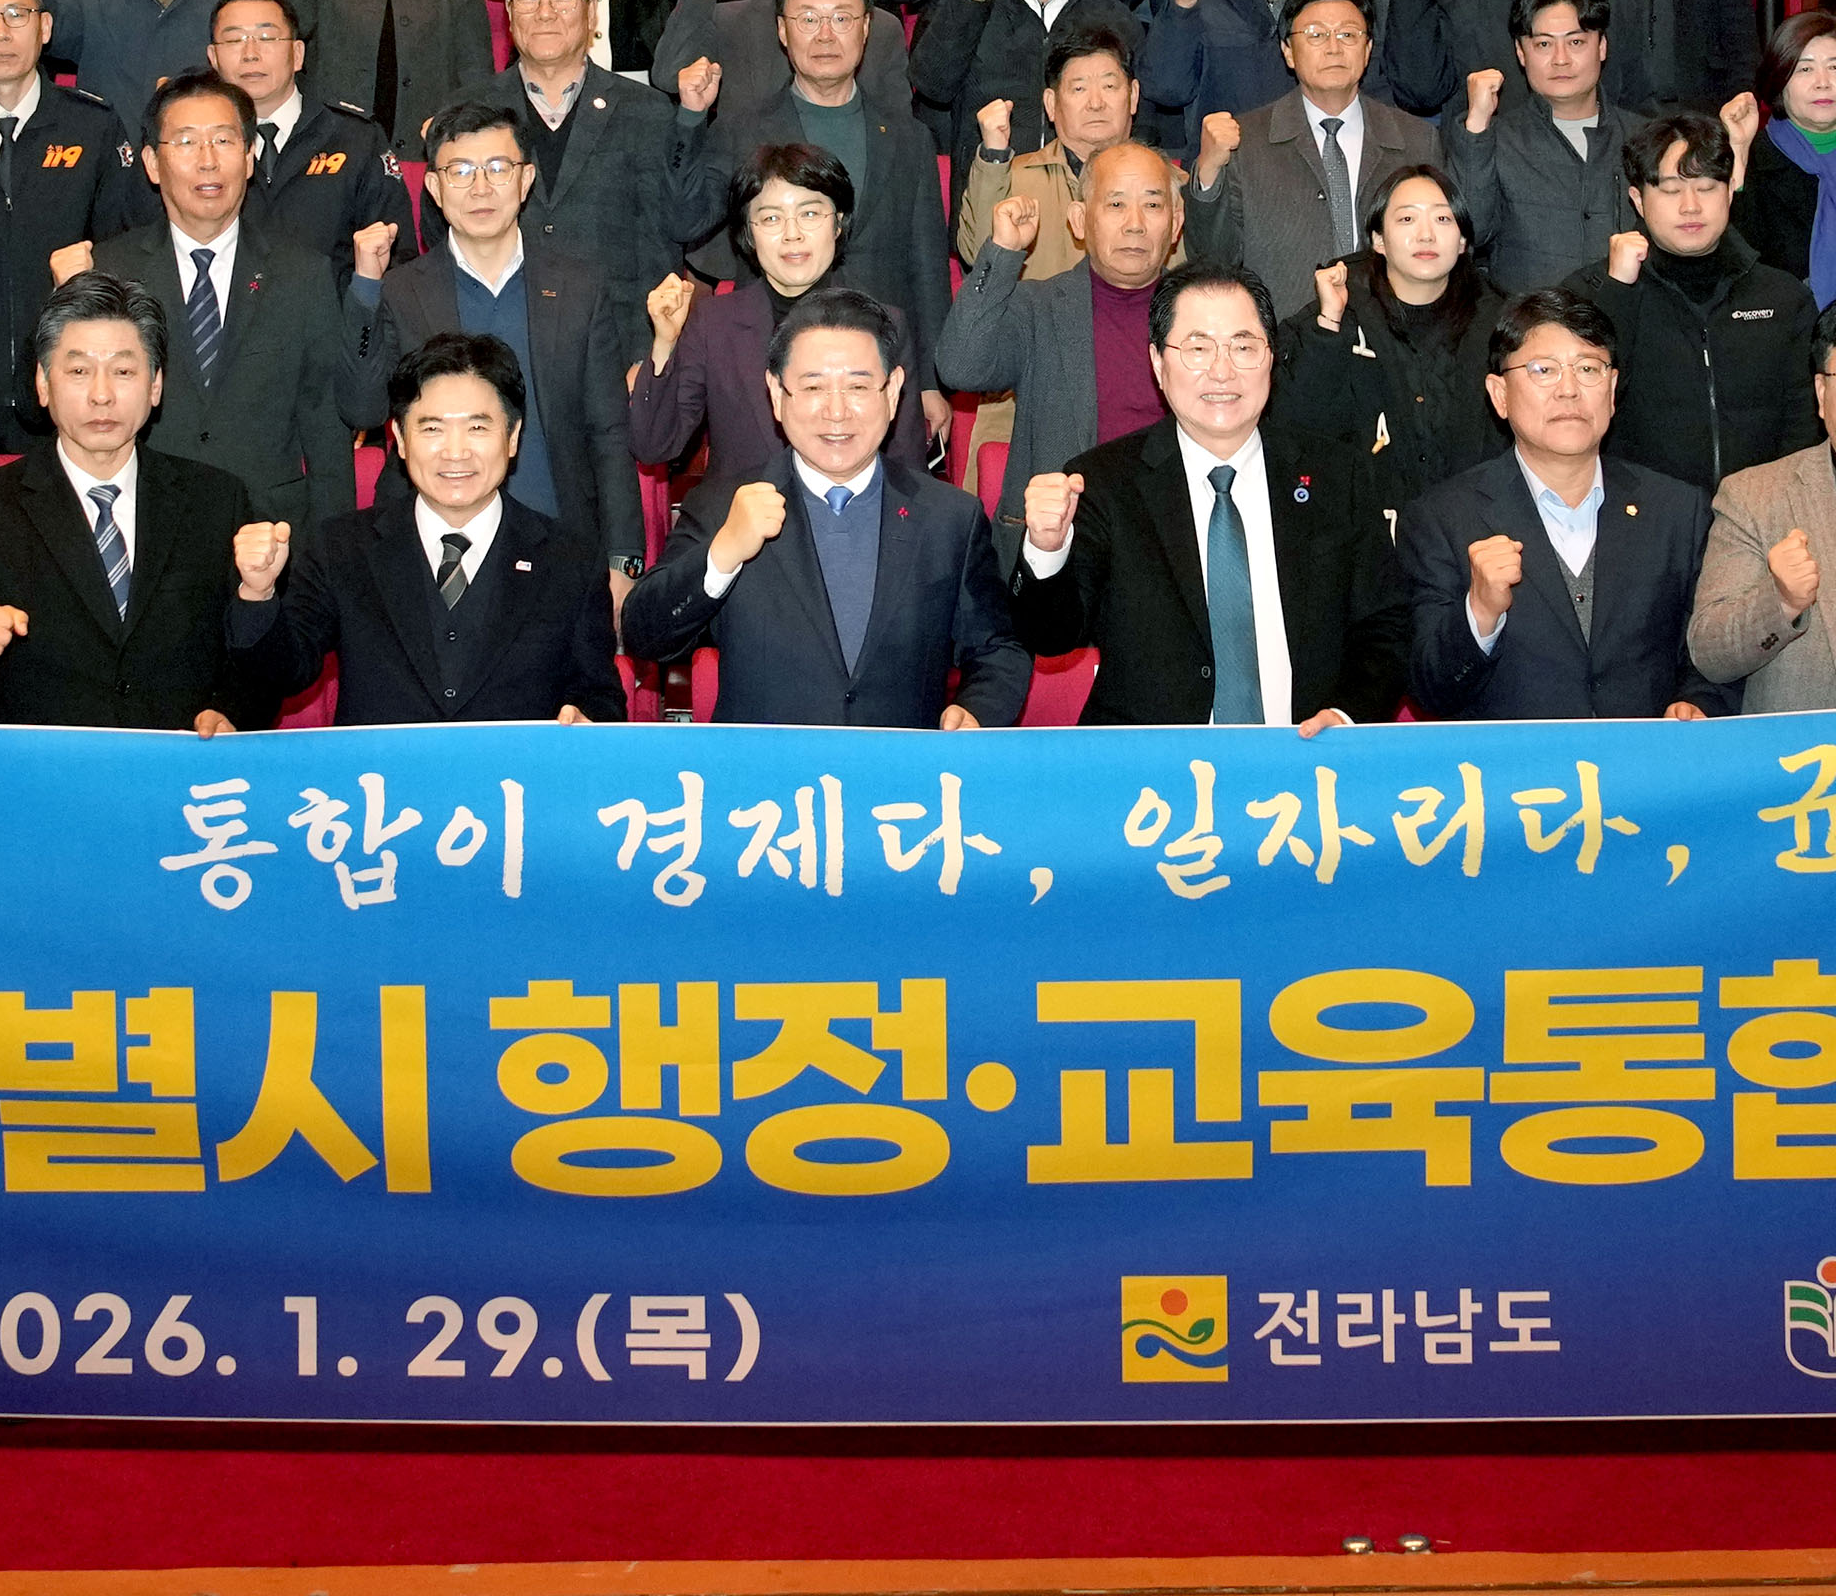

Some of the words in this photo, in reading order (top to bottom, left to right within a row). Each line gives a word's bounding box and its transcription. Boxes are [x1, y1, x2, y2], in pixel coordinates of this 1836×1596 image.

[42, 145, 83, 167] 119
[306, 152, 346, 175] 119
[159, 772, 525, 911] 통합이
[596, 770, 1054, 907] 경제다,
[1123, 759, 1690, 900] 일자리다,
[284, 1296, 358, 1377] 1.
[405, 1293, 761, 1382] 29.(목)
[1253, 1288, 1561, 1366] 전라남도
